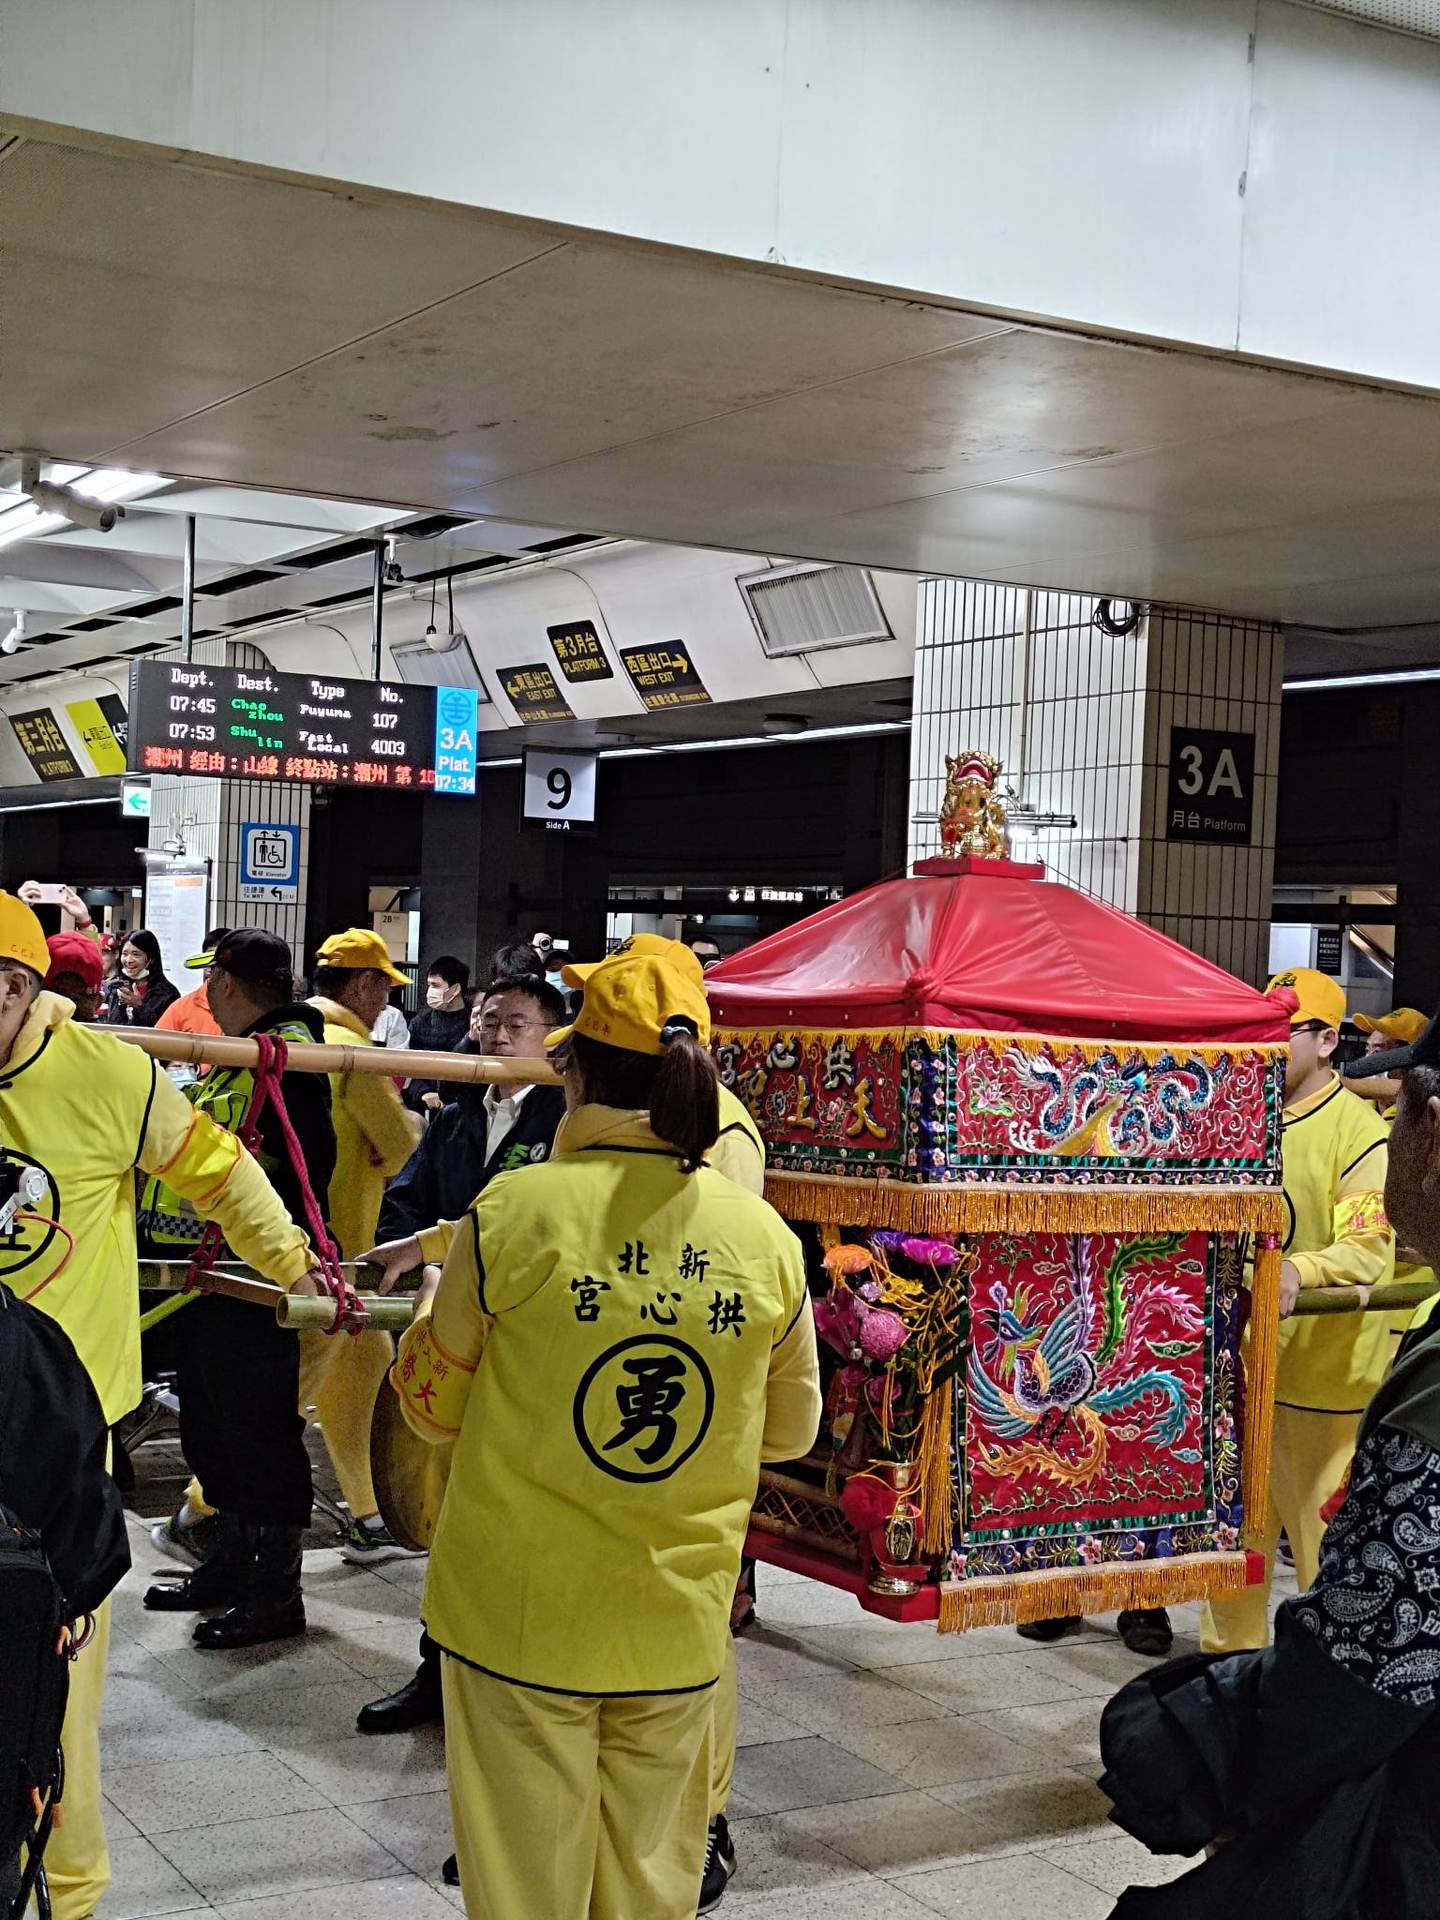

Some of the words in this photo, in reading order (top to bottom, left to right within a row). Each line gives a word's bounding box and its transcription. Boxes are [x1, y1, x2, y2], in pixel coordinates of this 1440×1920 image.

[553, 632, 599, 658] 第3月台
[562, 659, 600, 673] PLATFORM
[599, 657, 607, 668] 3
[624, 652, 673, 673] 西區出口
[171, 668, 214, 688] Dept.
[237, 673, 279, 692] Dest.
[311, 681, 345, 700] Type
[381, 687, 404, 703] No.
[514, 671, 553, 690] 東區出口
[637, 674, 658, 686] WEST
[658, 671, 675, 684] EXIT
[526, 690, 542, 701] EAST
[543, 688, 557, 699] EXIT
[170, 696, 216, 714] 07:45
[231, 698, 267, 711] Chao
[372, 713, 398, 728] 107
[248, 709, 284, 722] zhou
[14, 716, 66, 756] 第三月台
[169, 723, 215, 741] 07:53
[230, 725, 257, 738] Shu
[299, 731, 333, 743] Fast
[371, 739, 406, 755] 4003
[257, 737, 283, 749] lin
[307, 741, 349, 754] Local
[439, 728, 474, 751] 3A
[1178, 745, 1244, 798] 3A
[435, 775, 475, 791] 07:34
[547, 767, 572, 810] 9
[545, 821, 562, 830] Side
[562, 820, 570, 830] A
[1172, 810, 1201, 829] 月台
[1204, 818, 1246, 832] Platform
[602, 1354, 687, 1465] 勇
